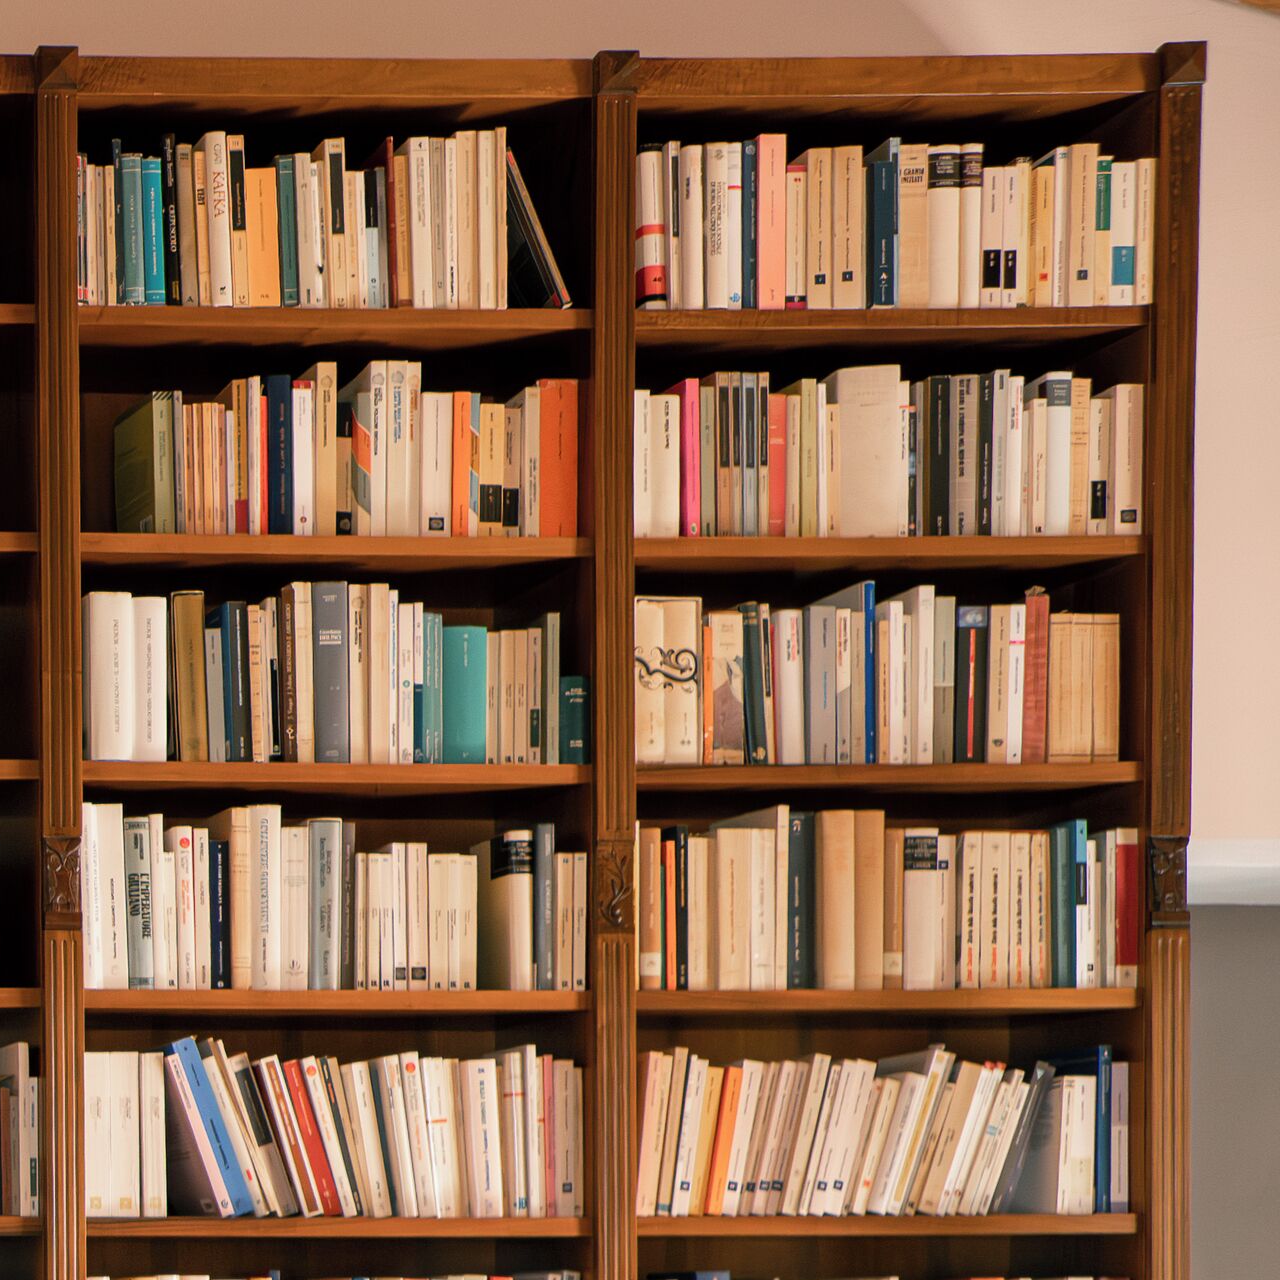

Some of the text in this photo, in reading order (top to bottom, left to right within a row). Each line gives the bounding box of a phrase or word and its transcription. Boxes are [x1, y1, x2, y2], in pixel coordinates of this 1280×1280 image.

[212, 171, 226, 218] KAFKA
[903, 168, 924, 176] GRANDI
[128, 874, 140, 918] GIULIANO
[140, 873, 151, 940] L'IMPERATORE
